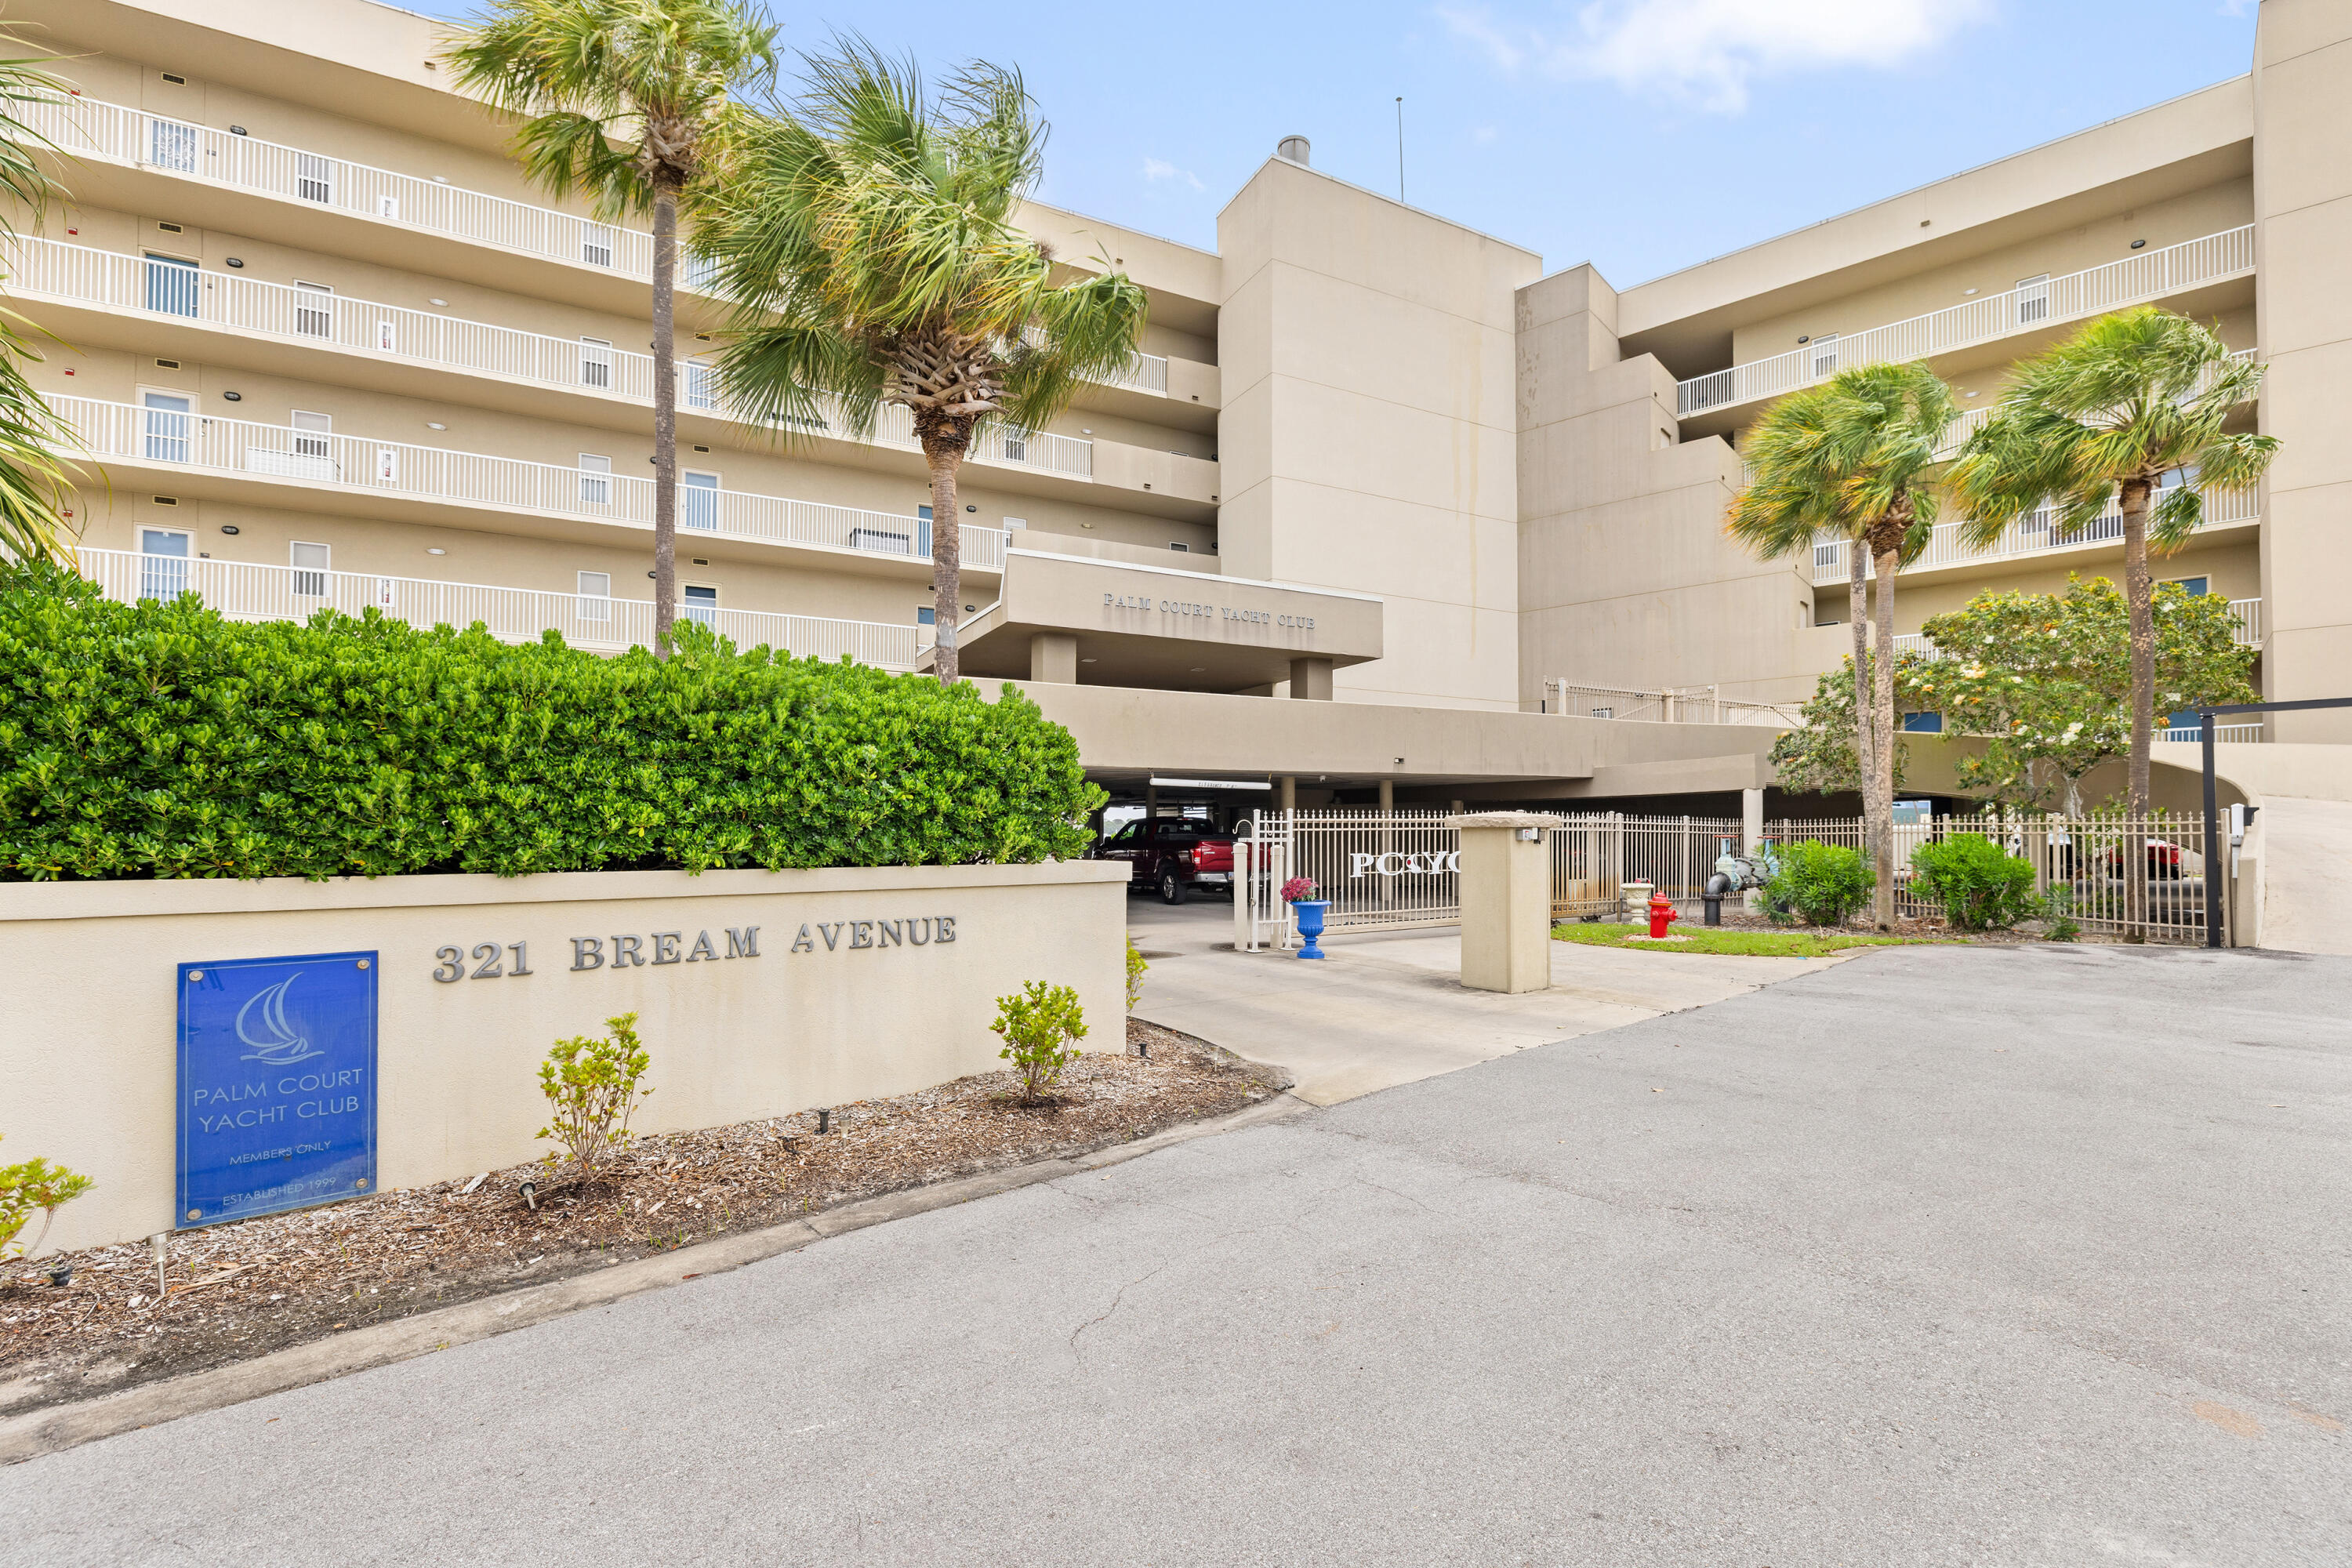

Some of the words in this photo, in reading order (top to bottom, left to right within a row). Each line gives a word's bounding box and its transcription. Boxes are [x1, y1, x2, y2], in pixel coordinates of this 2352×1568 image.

[1104, 593, 1151, 610] PALM
[1160, 600, 1213, 617] COURT
[1221, 607, 1270, 624] YACHT
[1278, 614, 1316, 629] CLUB
[433, 940, 534, 983] 321
[570, 925, 760, 972] BREAM
[790, 915, 956, 953] AVENUE
[194, 1082, 267, 1106] PALM
[278, 1069, 363, 1094] COURT
[199, 1105, 288, 1133] YACHT
[297, 1096, 359, 1118] CLUB
[230, 1147, 292, 1166] MEMBERS
[296, 1141, 332, 1155] ONLY
[223, 1183, 304, 1206] ESTABLISHED
[309, 1177, 336, 1189] 1999
